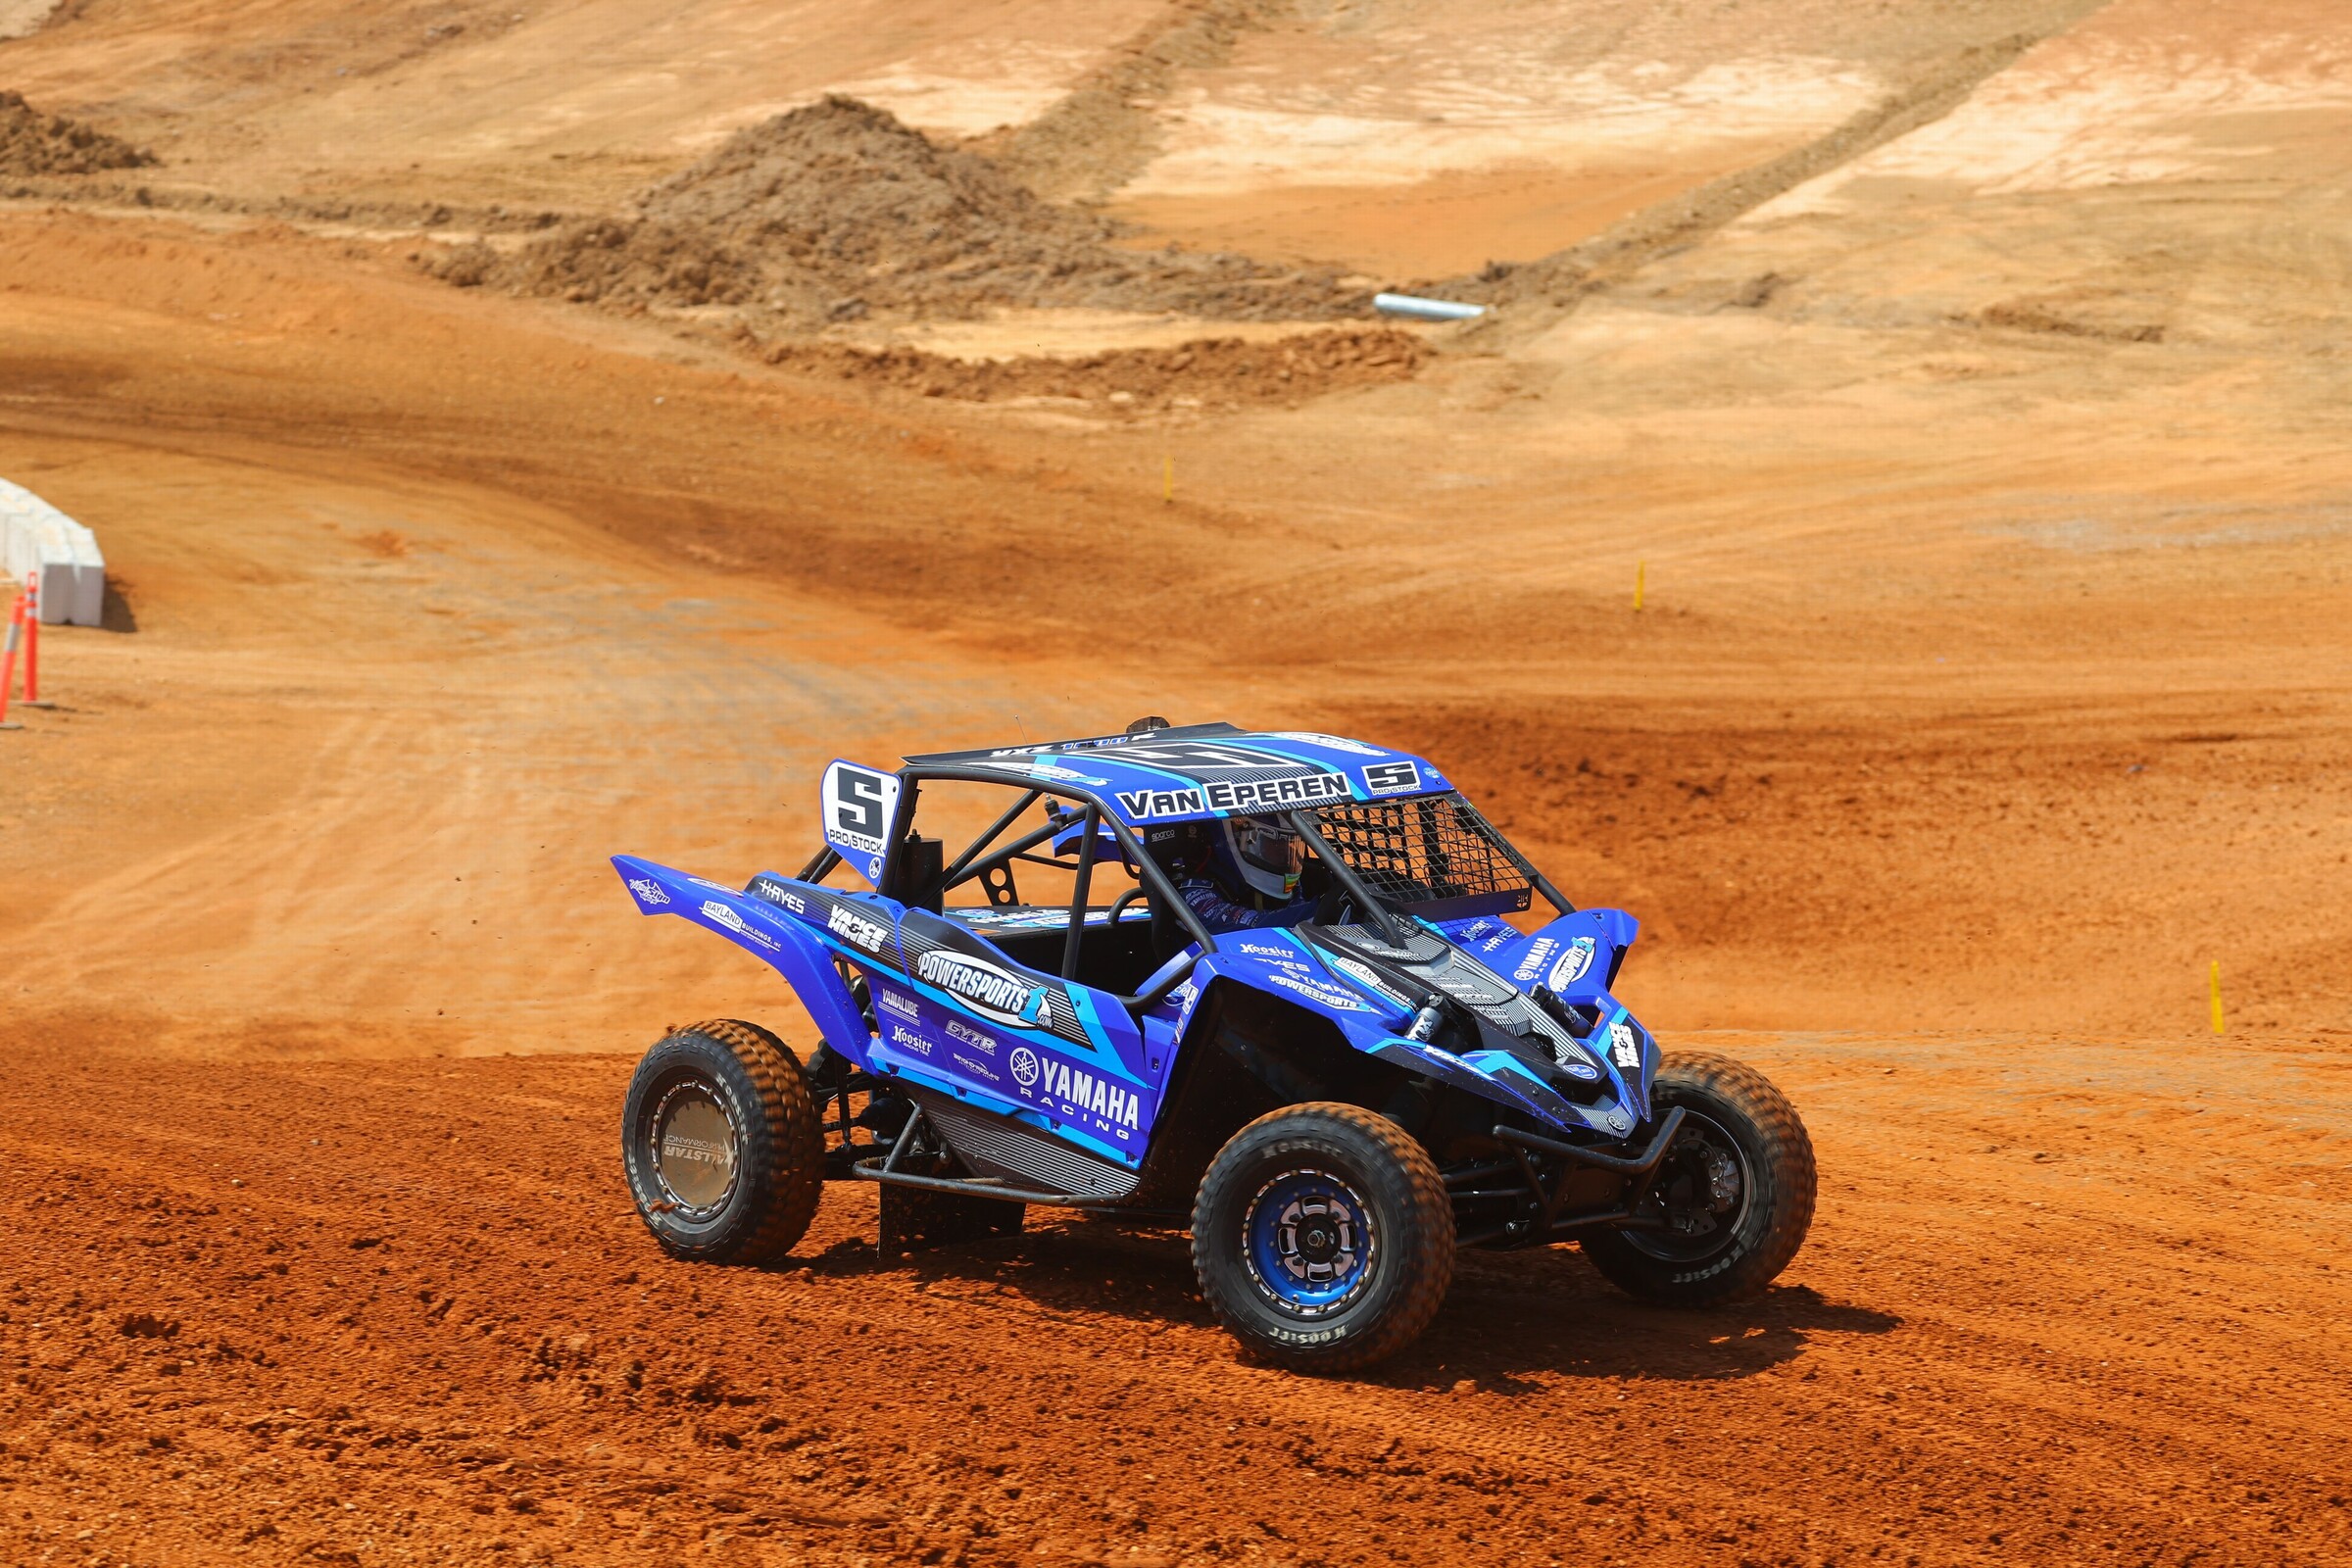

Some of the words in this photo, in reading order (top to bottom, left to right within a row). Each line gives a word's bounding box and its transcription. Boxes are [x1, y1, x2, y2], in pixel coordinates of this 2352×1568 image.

[1366, 763, 1416, 788] 5
[837, 767, 882, 839] 5
[1119, 790, 1201, 816] VAN
[1206, 774, 1349, 808] EPEREN
[829, 829, 849, 844] PRO
[851, 835, 883, 855] STOCK
[1151, 829, 1175, 841] sparco
[759, 879, 806, 915] HAYES
[705, 902, 741, 926] BAYLAND
[831, 904, 889, 942] VANCE
[827, 916, 882, 954] HINES
[1240, 944, 1295, 958] Hoosier
[1482, 926, 1517, 953] HAYES
[1519, 938, 1555, 970] YAMAHA
[1534, 942, 1560, 979] RACING
[918, 952, 1030, 1013] POWERSPORTS
[1341, 958, 1379, 983] BAYLAND
[882, 988, 919, 1018] YAMALUBE
[1270, 975, 1358, 1007] POWERSPORTS
[891, 1025, 933, 1054] Hoosier
[945, 1019, 998, 1054] GYTR
[1608, 1021, 1630, 1067] VANCE
[1619, 1024, 1641, 1068] HINES
[1042, 1057, 1140, 1132] YAMAHA
[1019, 1087, 1130, 1141] RACING
[663, 1134, 725, 1151] PERFORMANCE
[663, 1145, 725, 1166] ALLSTAR
